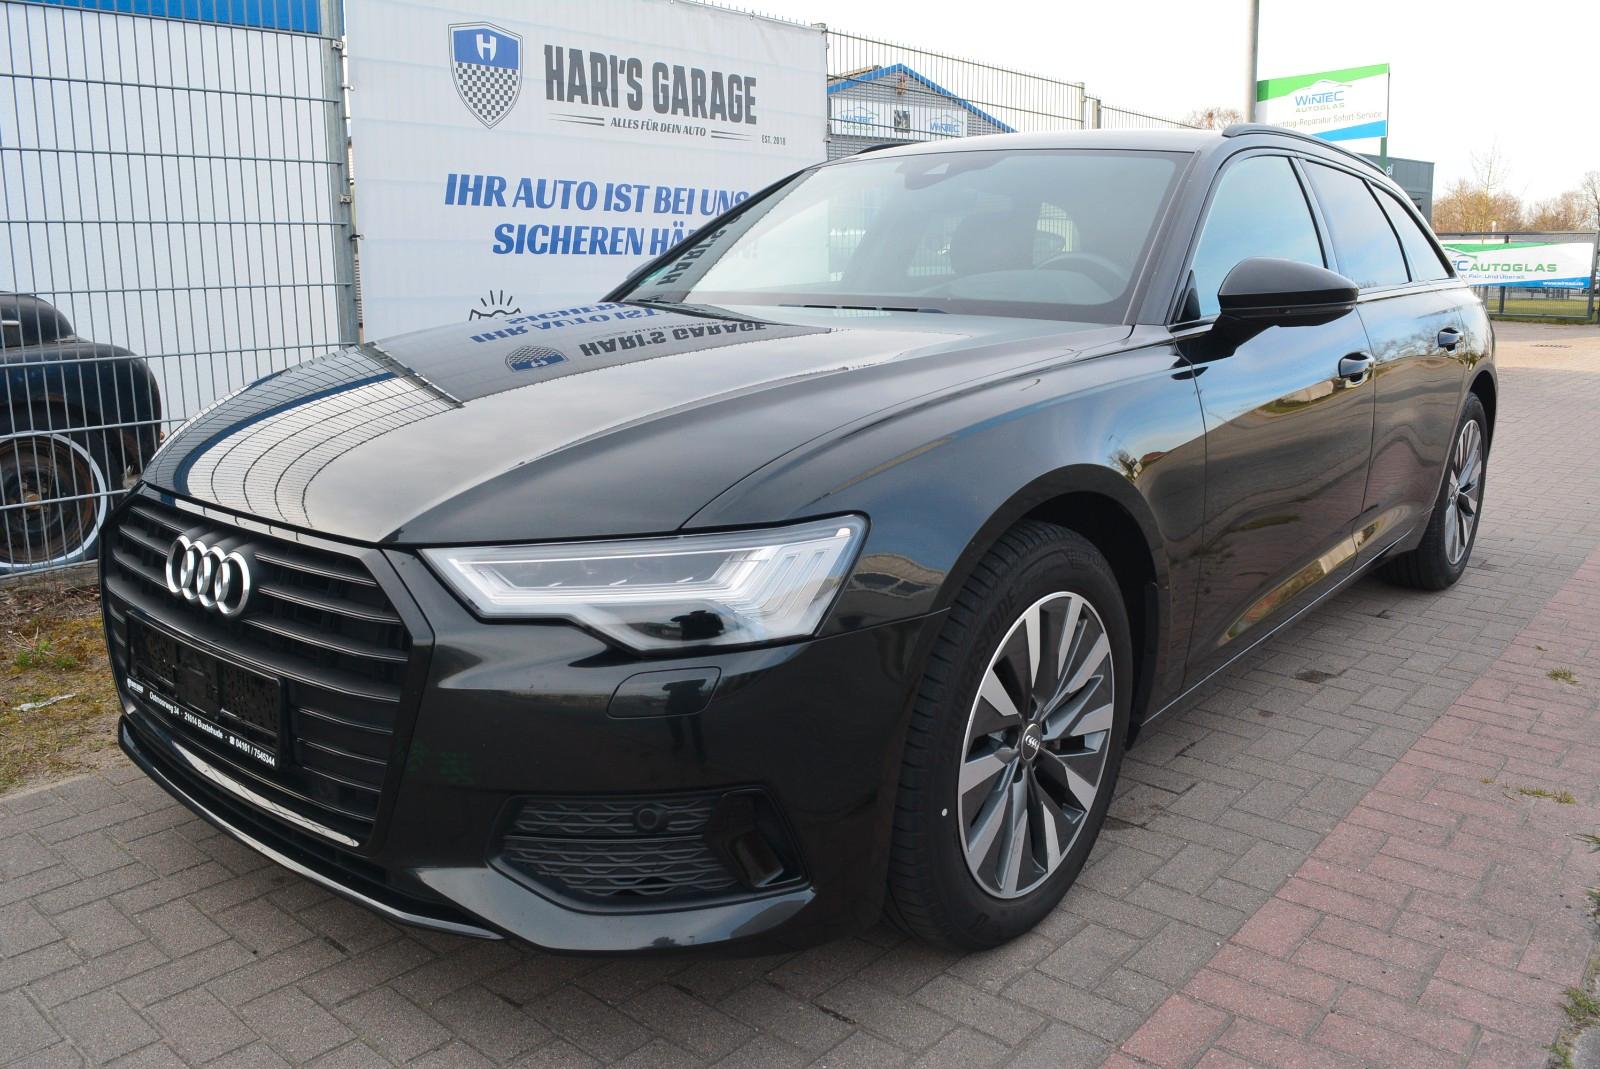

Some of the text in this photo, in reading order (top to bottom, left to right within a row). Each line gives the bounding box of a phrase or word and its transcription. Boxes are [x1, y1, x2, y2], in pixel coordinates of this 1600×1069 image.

[544, 44, 757, 125] HARI'S GARAGE
[1295, 103, 1345, 113] AUTOGLAS
[610, 117, 706, 137] ALLES FÜR DEIN AUTO
[762, 134, 772, 144] EST.
[444, 173, 507, 208] IHR
[512, 177, 598, 211] AUTO
[603, 183, 650, 213] IST
[653, 186, 696, 215] BEI
[492, 223, 644, 256] SICHEREN
[1470, 263, 1557, 273] AUTOGLAS
[173, 706, 180, 716] 34
[197, 719, 223, 739] Buxtehude
